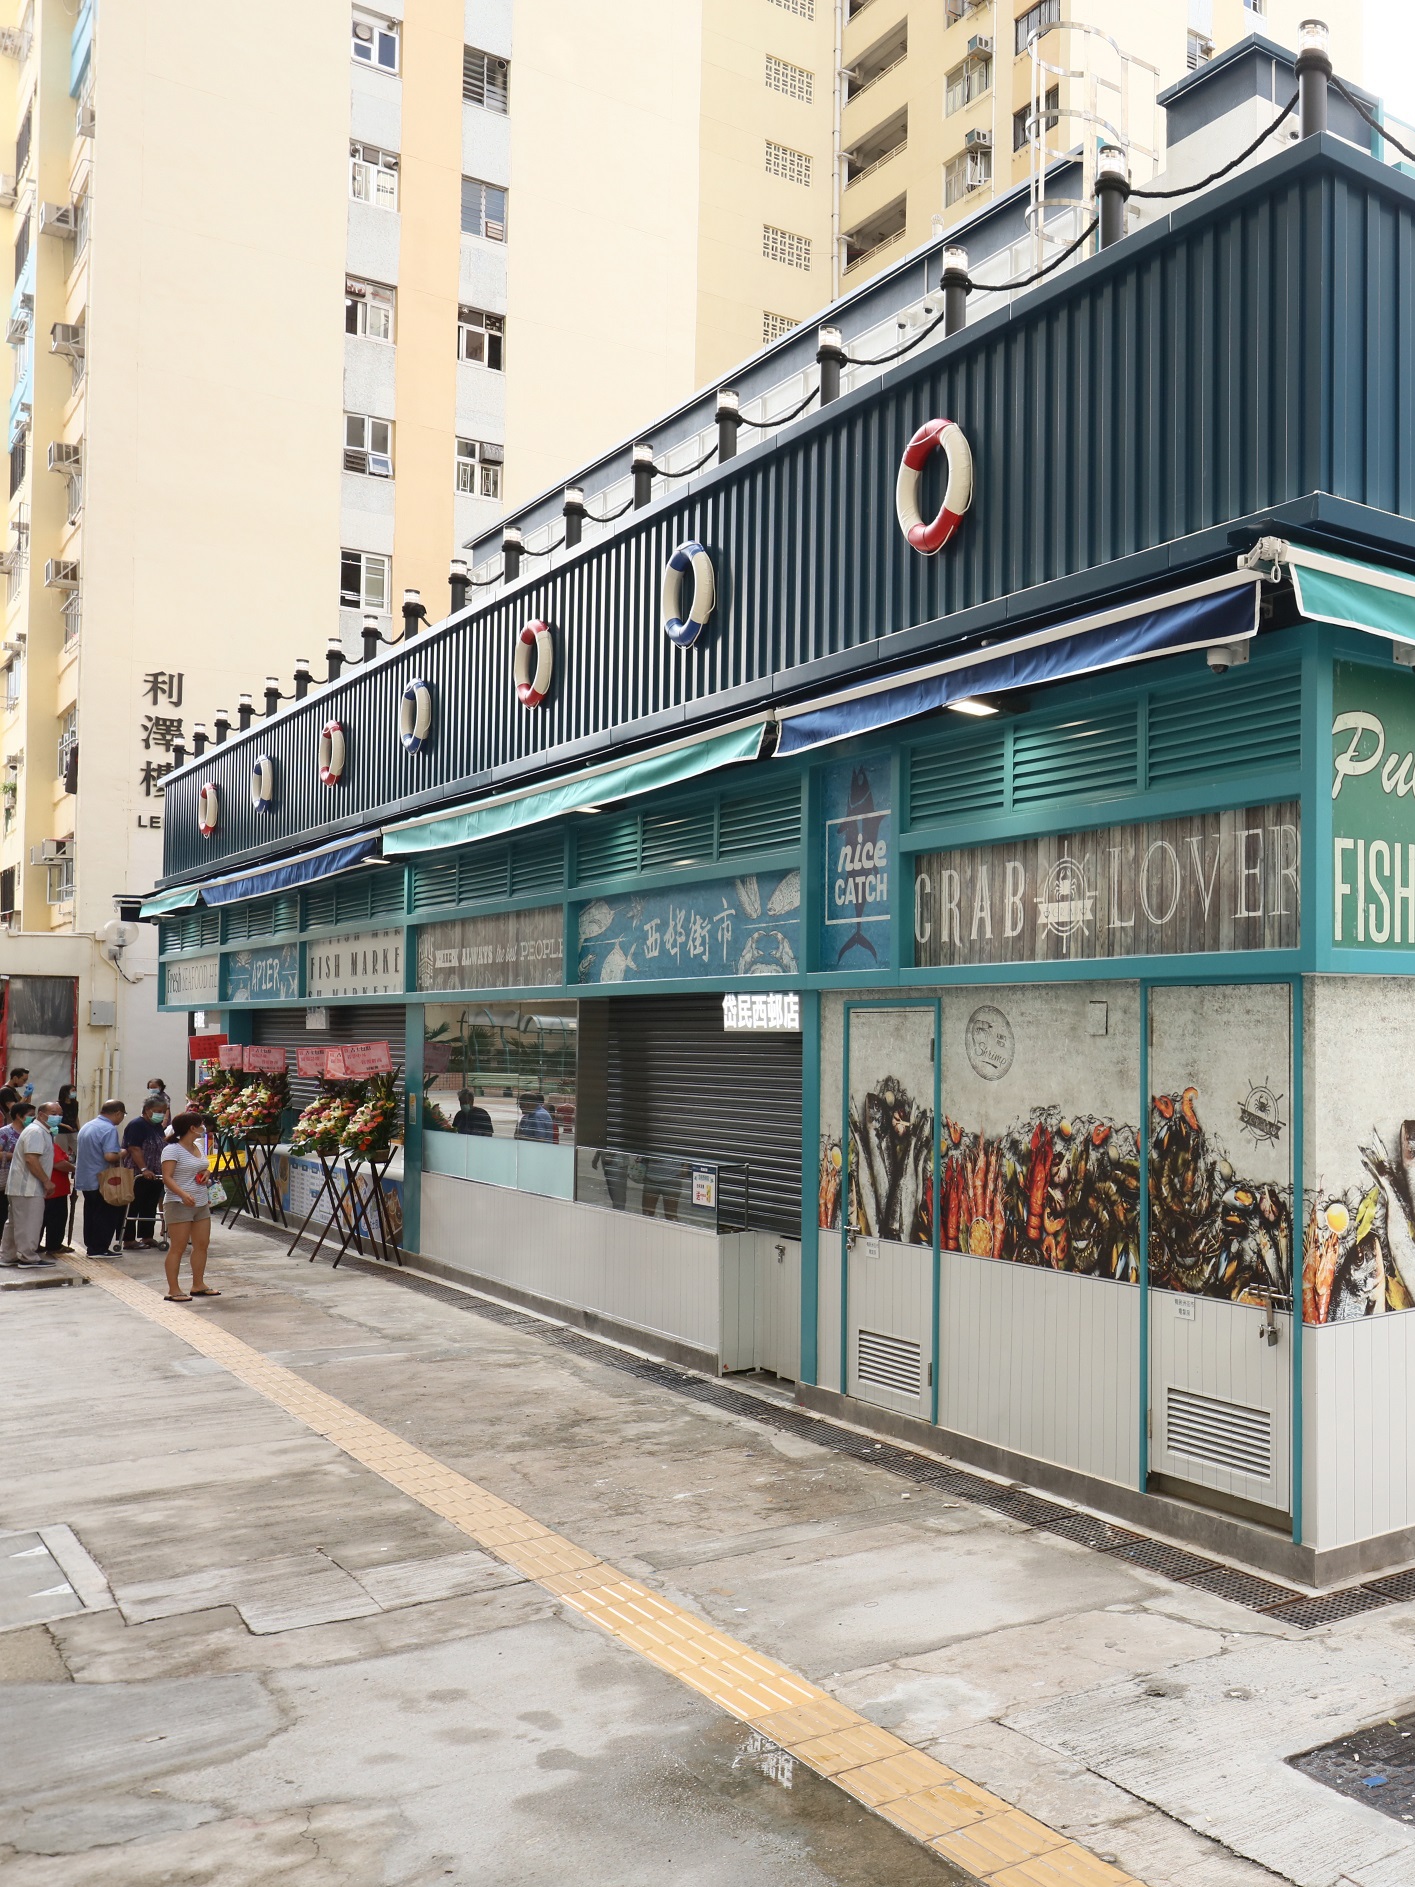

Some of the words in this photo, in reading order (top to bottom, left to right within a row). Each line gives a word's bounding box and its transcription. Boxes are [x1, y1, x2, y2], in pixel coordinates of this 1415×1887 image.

[837, 833, 887, 873] nice
[834, 873, 888, 906] CATCH
[914, 860, 1026, 947] CRAB
[1105, 824, 1301, 928] LOVER
[1334, 837, 1415, 944] FISH
[643, 896, 736, 966] 西邨街市
[311, 953, 340, 981] FISH
[351, 947, 400, 977] MARKE
[461, 945, 492, 966] ALWAYS
[251, 957, 281, 992] APIER
[974, 1041, 1007, 1068] Shrimp
